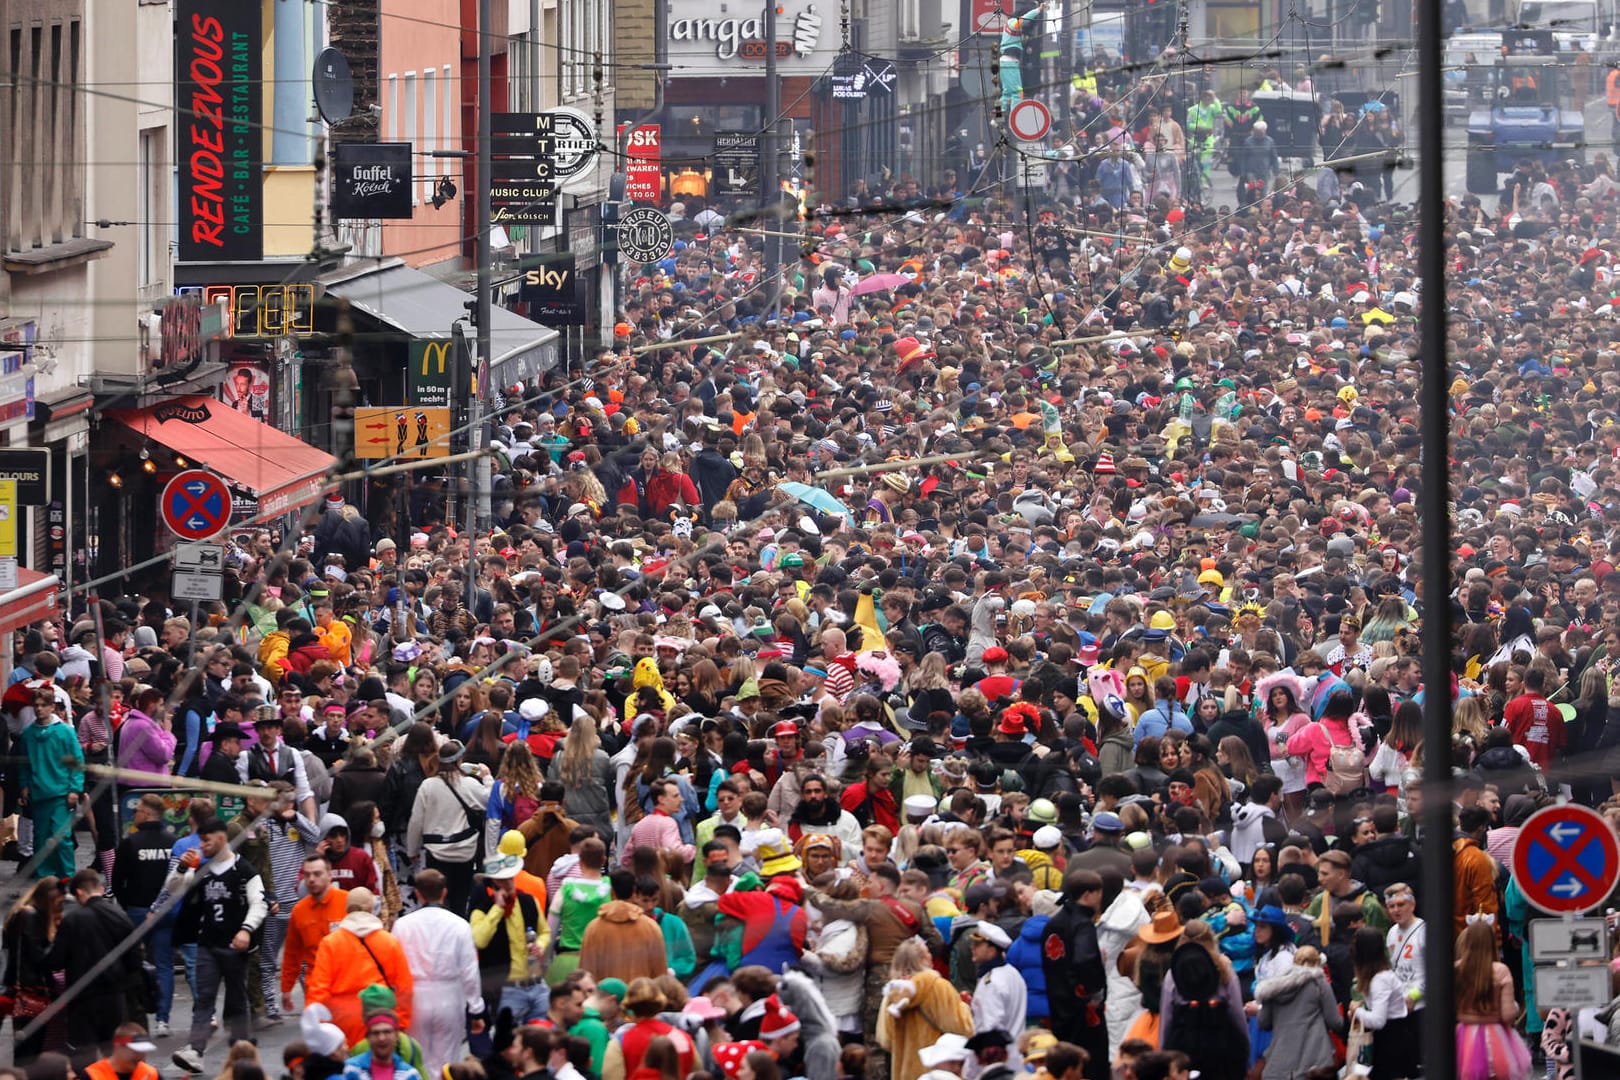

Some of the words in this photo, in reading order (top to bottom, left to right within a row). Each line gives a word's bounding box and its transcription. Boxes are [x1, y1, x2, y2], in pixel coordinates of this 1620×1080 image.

[232, 31, 249, 133] RESTAURANT
[191, 13, 224, 247] RENDEZVOUS
[536, 117, 550, 129] M
[538, 140, 549, 153] T
[234, 149, 249, 179] BAR
[537, 164, 548, 177] C
[352, 165, 393, 181] Gaffel
[351, 182, 393, 199] Kölsch
[231, 195, 250, 234] CAFÉ
[517, 212, 549, 220] KÖLSCH
[622, 241, 668, 262] 9383320
[526, 264, 568, 291] sky
[138, 848, 172, 860] SWAT
[214, 903, 225, 922] 2
[1403, 944, 1413, 959] 2
